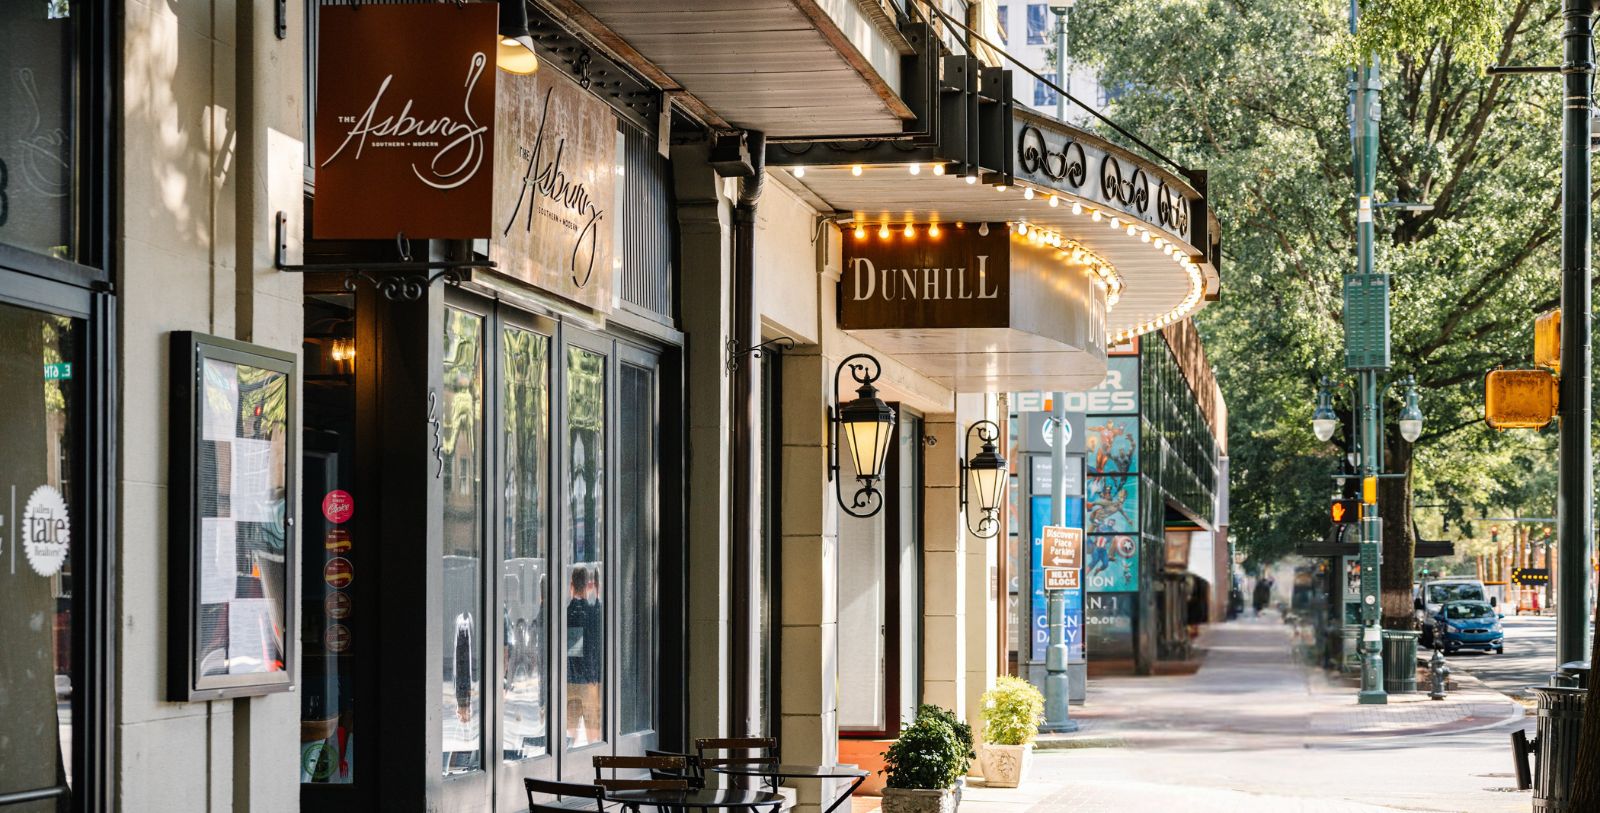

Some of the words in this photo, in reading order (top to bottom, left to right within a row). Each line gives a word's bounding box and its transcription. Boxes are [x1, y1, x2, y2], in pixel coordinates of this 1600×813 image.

[321, 74, 488, 178] Asbury
[504, 86, 603, 289] Asbury
[30, 506, 66, 545] tate
[1046, 528, 1079, 541] Discovery
[1054, 538, 1072, 548] Place
[1050, 546, 1075, 559] Parking
[1051, 570, 1074, 579] NEXT
[1048, 578, 1076, 586] BLOCK
